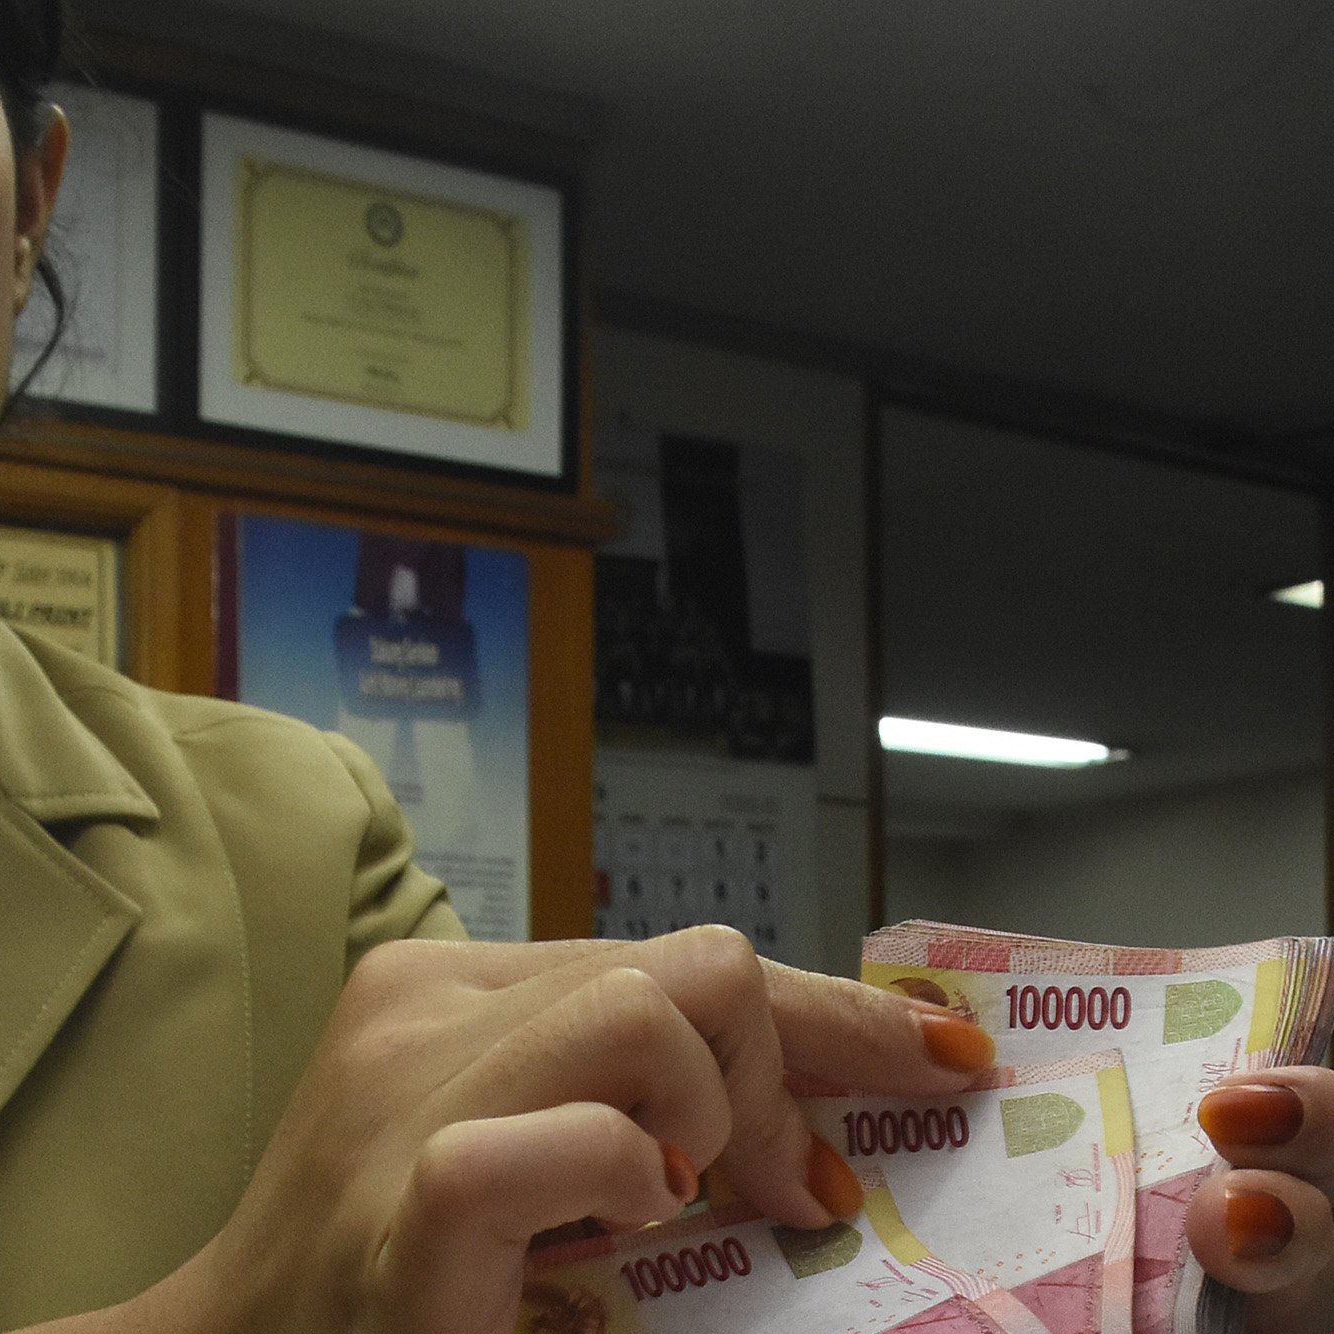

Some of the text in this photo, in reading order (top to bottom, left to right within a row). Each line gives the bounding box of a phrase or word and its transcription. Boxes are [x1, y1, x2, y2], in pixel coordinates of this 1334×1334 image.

[1006, 984, 1132, 1031] 100000
[843, 1105, 969, 1157] 100000
[621, 1236, 752, 1301] 100000
